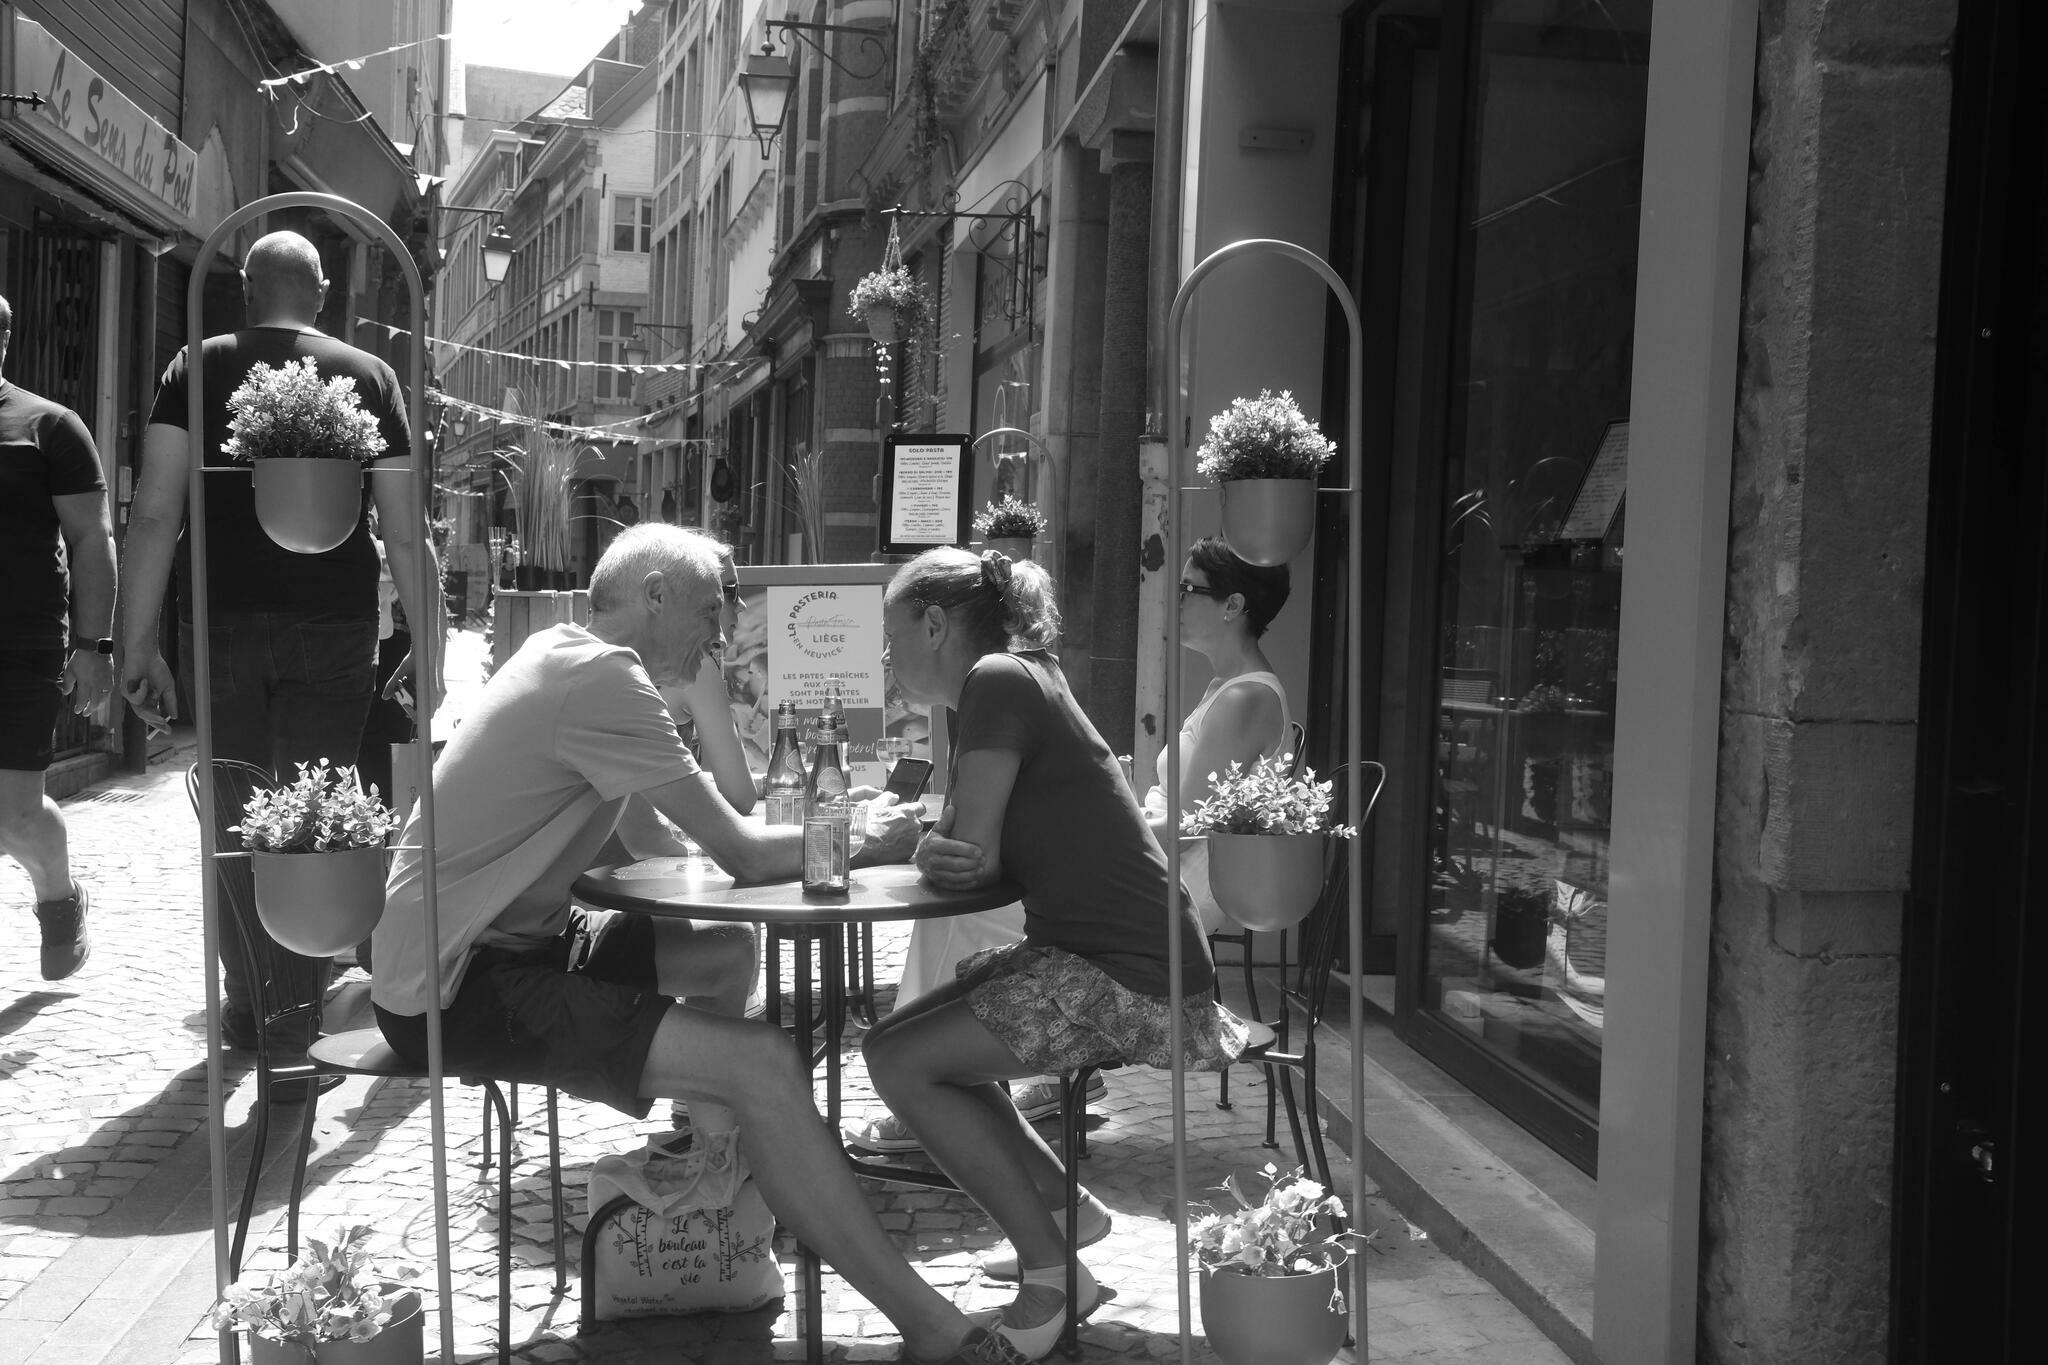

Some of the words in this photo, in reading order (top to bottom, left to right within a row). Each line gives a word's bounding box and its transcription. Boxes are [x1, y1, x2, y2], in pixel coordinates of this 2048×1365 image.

[43, 48, 72, 129] Le
[84, 77, 126, 170] Sens
[133, 121, 154, 188] du
[161, 133, 195, 215] Poil
[789, 590, 838, 619] PASTERIA
[787, 623, 797, 637] LA
[812, 633, 846, 643] LIÈGE
[793, 638, 804, 649] EN
[803, 646, 843, 659] NEUVICE
[799, 672, 825, 680] PATES
[829, 671, 870, 679] FRAÎCHES
[671, 1216, 689, 1234] Le
[658, 1238, 707, 1253] bouleau
[662, 1257, 688, 1270] c'est
[694, 1256, 706, 1269] la
[680, 1273, 701, 1286] vie
